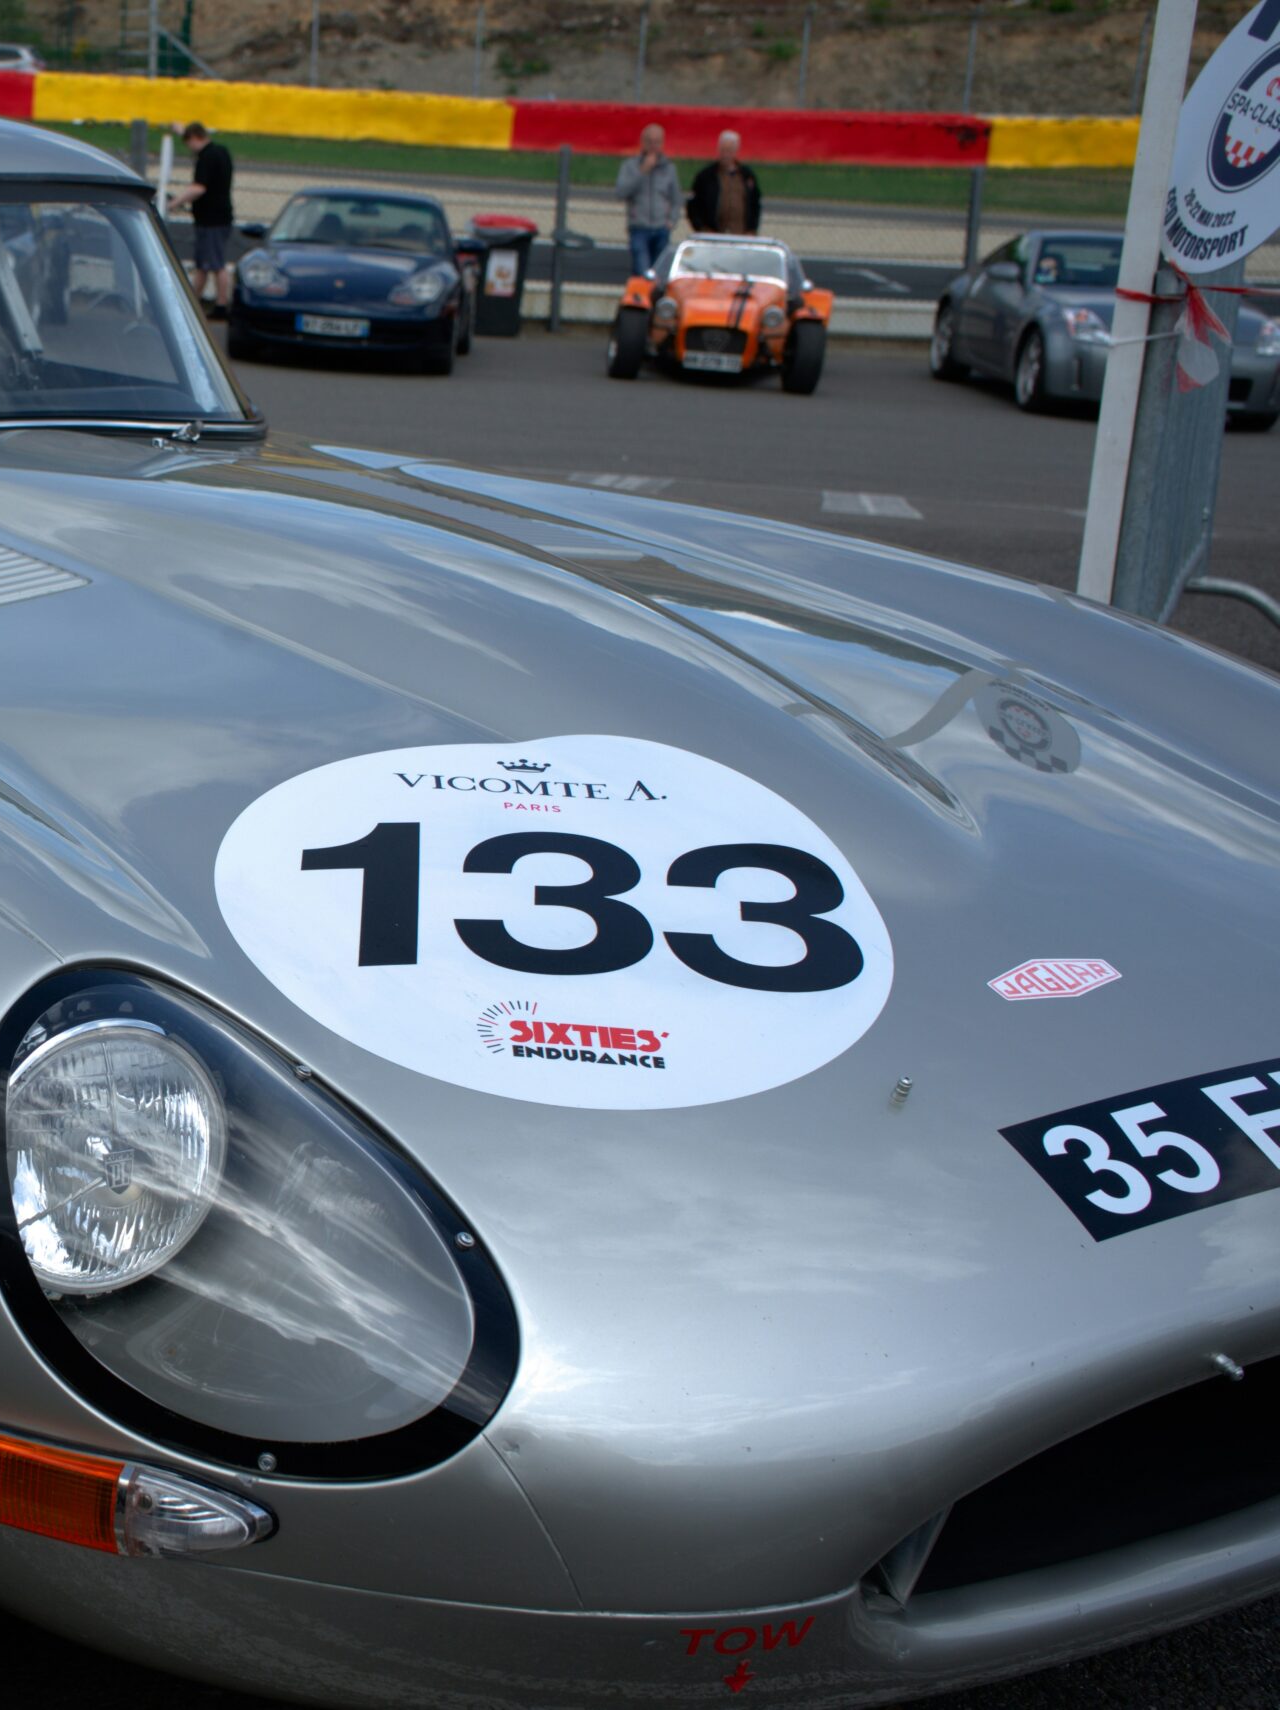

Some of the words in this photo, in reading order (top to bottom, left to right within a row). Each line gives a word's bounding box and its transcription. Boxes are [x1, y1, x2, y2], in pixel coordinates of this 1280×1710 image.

[1166, 216, 1249, 260] MOTORSPORT
[393, 773, 609, 800] VICOMTE
[503, 801, 561, 813] PARIS
[300, 822, 864, 993] 133
[1003, 962, 1110, 996] JAGUAR
[512, 1044, 666, 1069] ENDURANCE
[1043, 1101, 1221, 1215] 35
[680, 1615, 816, 1656] TOW
